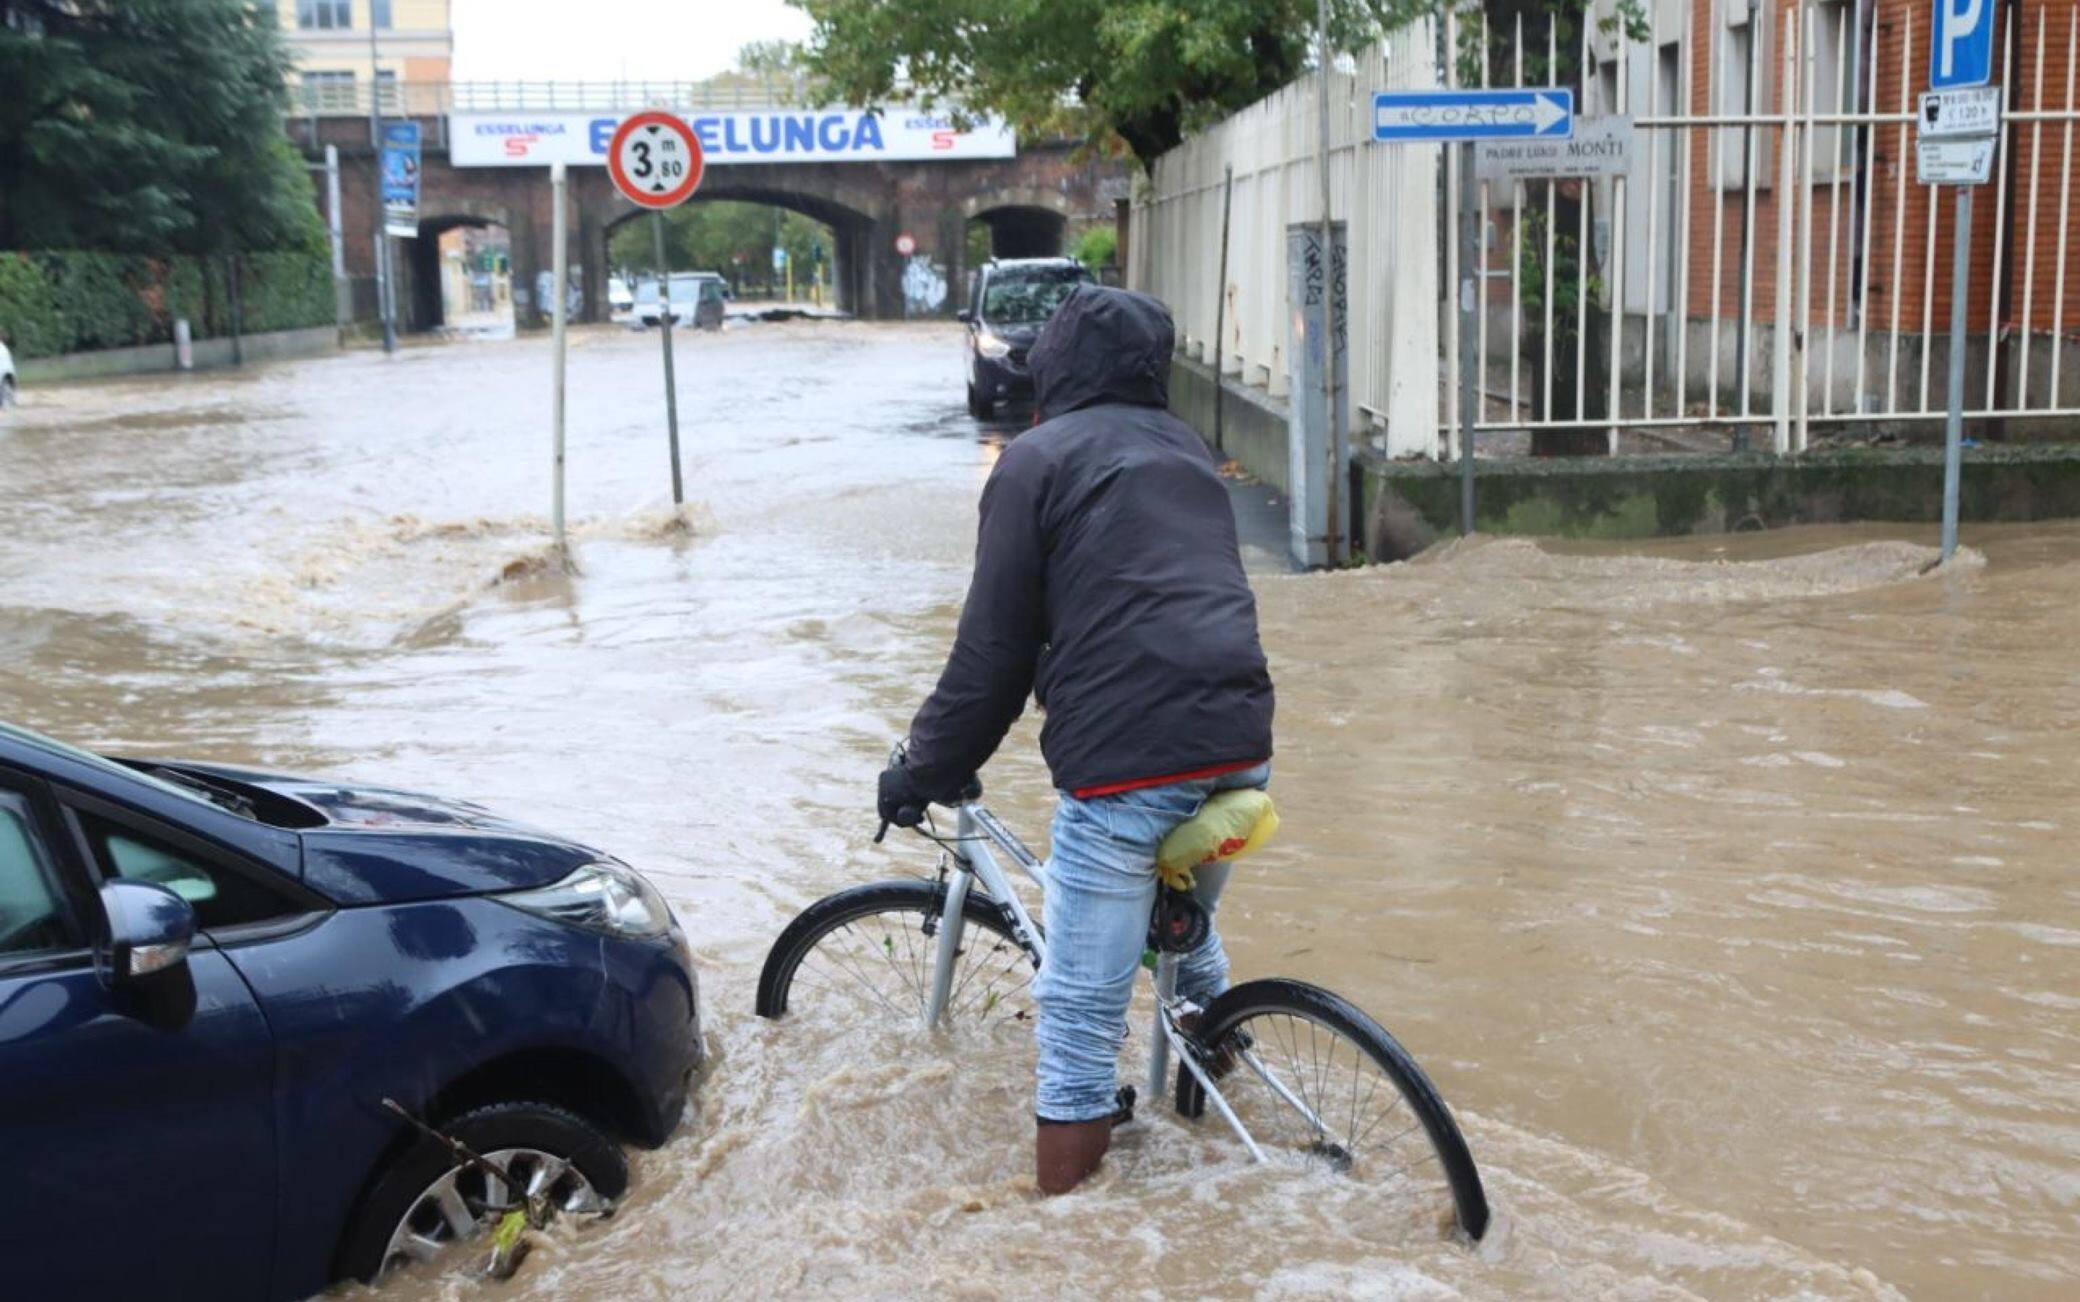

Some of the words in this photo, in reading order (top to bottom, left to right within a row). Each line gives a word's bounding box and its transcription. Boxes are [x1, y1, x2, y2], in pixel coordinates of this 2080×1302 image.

[1941, 0, 1983, 78] P
[589, 113, 885, 155] EELUNGA
[1567, 141, 1623, 157] MONTI
